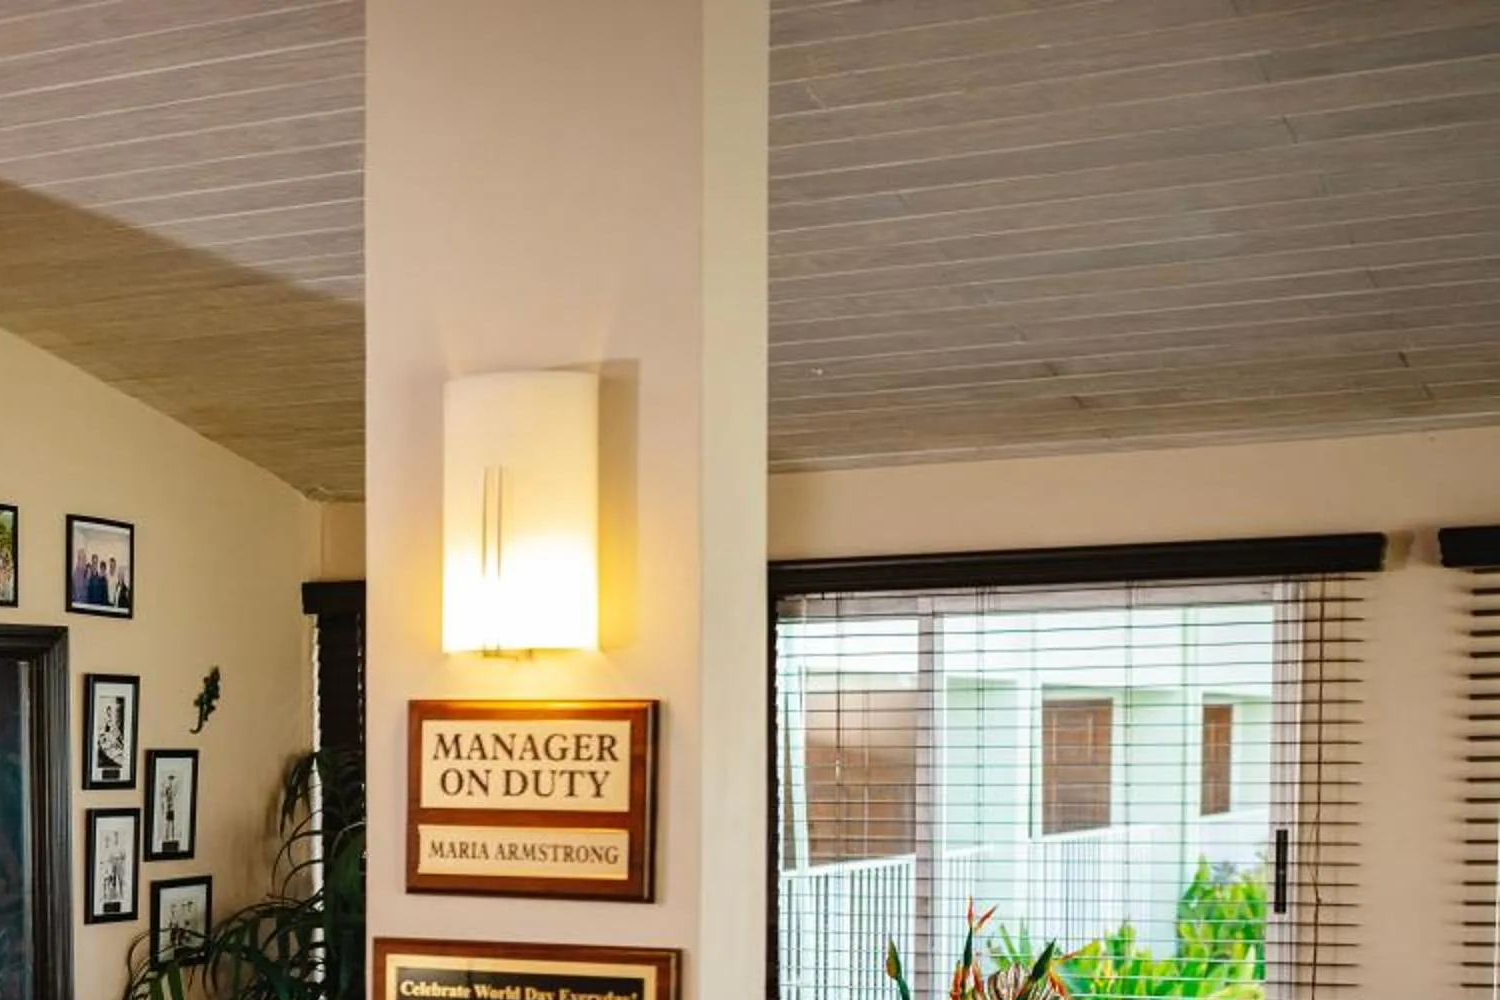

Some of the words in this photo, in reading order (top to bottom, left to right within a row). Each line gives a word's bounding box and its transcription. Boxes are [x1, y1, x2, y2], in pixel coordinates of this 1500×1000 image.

[433, 733, 619, 762] MANAGER
[440, 768, 492, 797] ON
[502, 769, 611, 798] DUTY
[428, 840, 489, 860] MARIA
[494, 843, 620, 864] ARMSTRONG
[400, 980, 471, 998] Celebrate
[473, 984, 521, 1000] World
